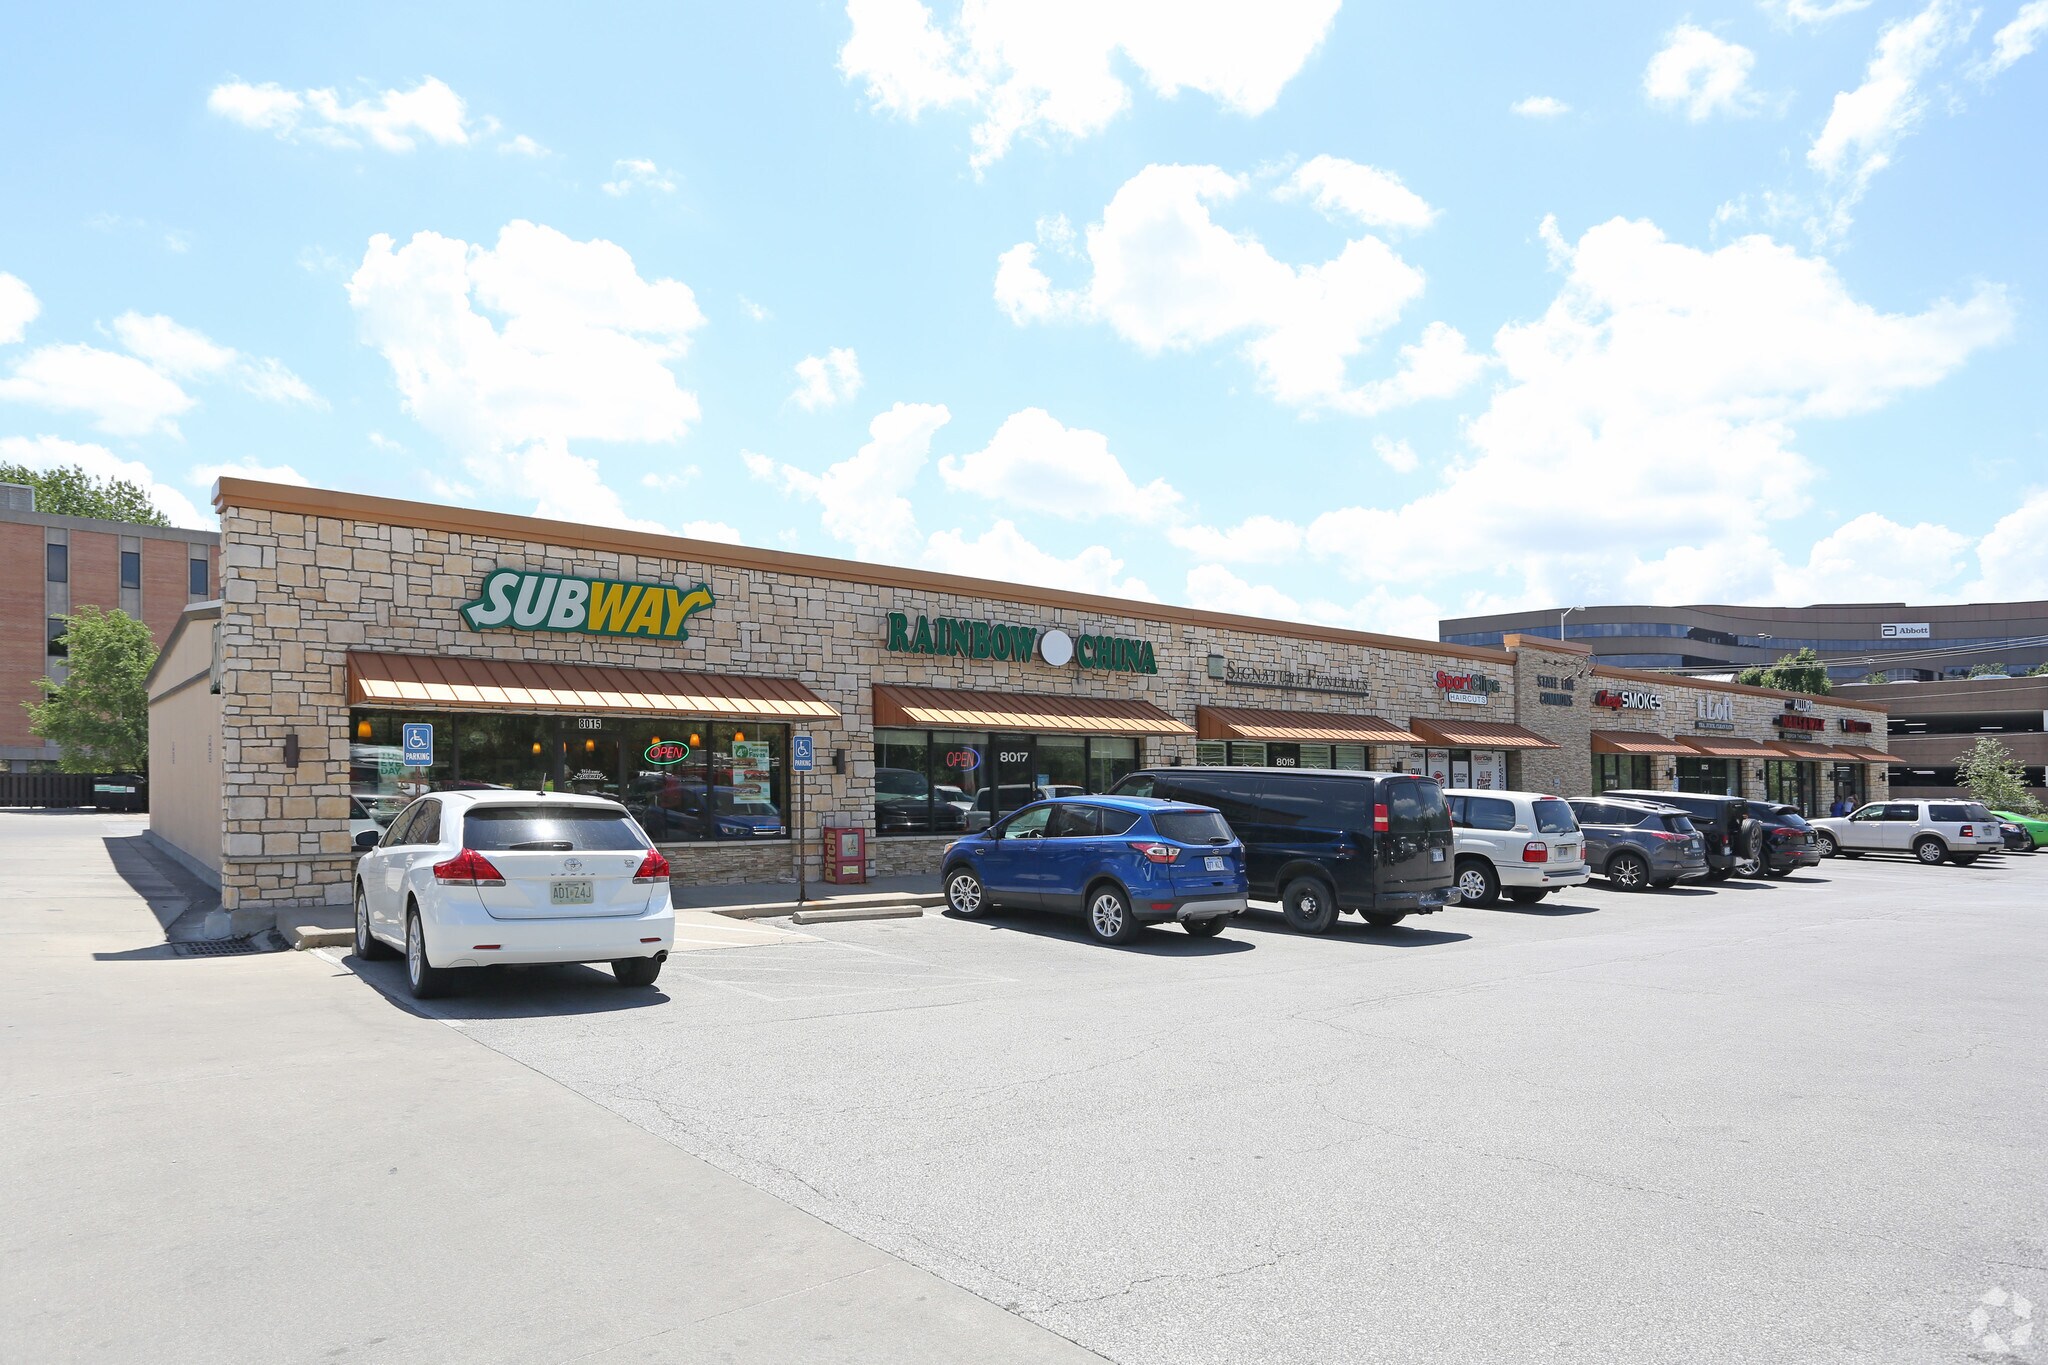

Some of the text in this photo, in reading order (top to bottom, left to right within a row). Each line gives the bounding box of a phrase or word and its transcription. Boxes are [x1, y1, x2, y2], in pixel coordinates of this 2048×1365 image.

[466, 572, 713, 637] SUBWAY
[887, 612, 1158, 675] RAINBOW CHINA
[1537, 675, 1558, 689] STATE
[1450, 694, 1487, 704] HAIRCUTS
[1621, 691, 1661, 710] SMOKES
[580, 719, 601, 729] 8015
[405, 752, 430, 761] PARKING
[650, 746, 683, 759] OPEN
[1000, 752, 1029, 762] 8017
[794, 759, 812, 767] PARKING
[946, 752, 974, 767] OPEN
[1276, 757, 1295, 767] 8019
